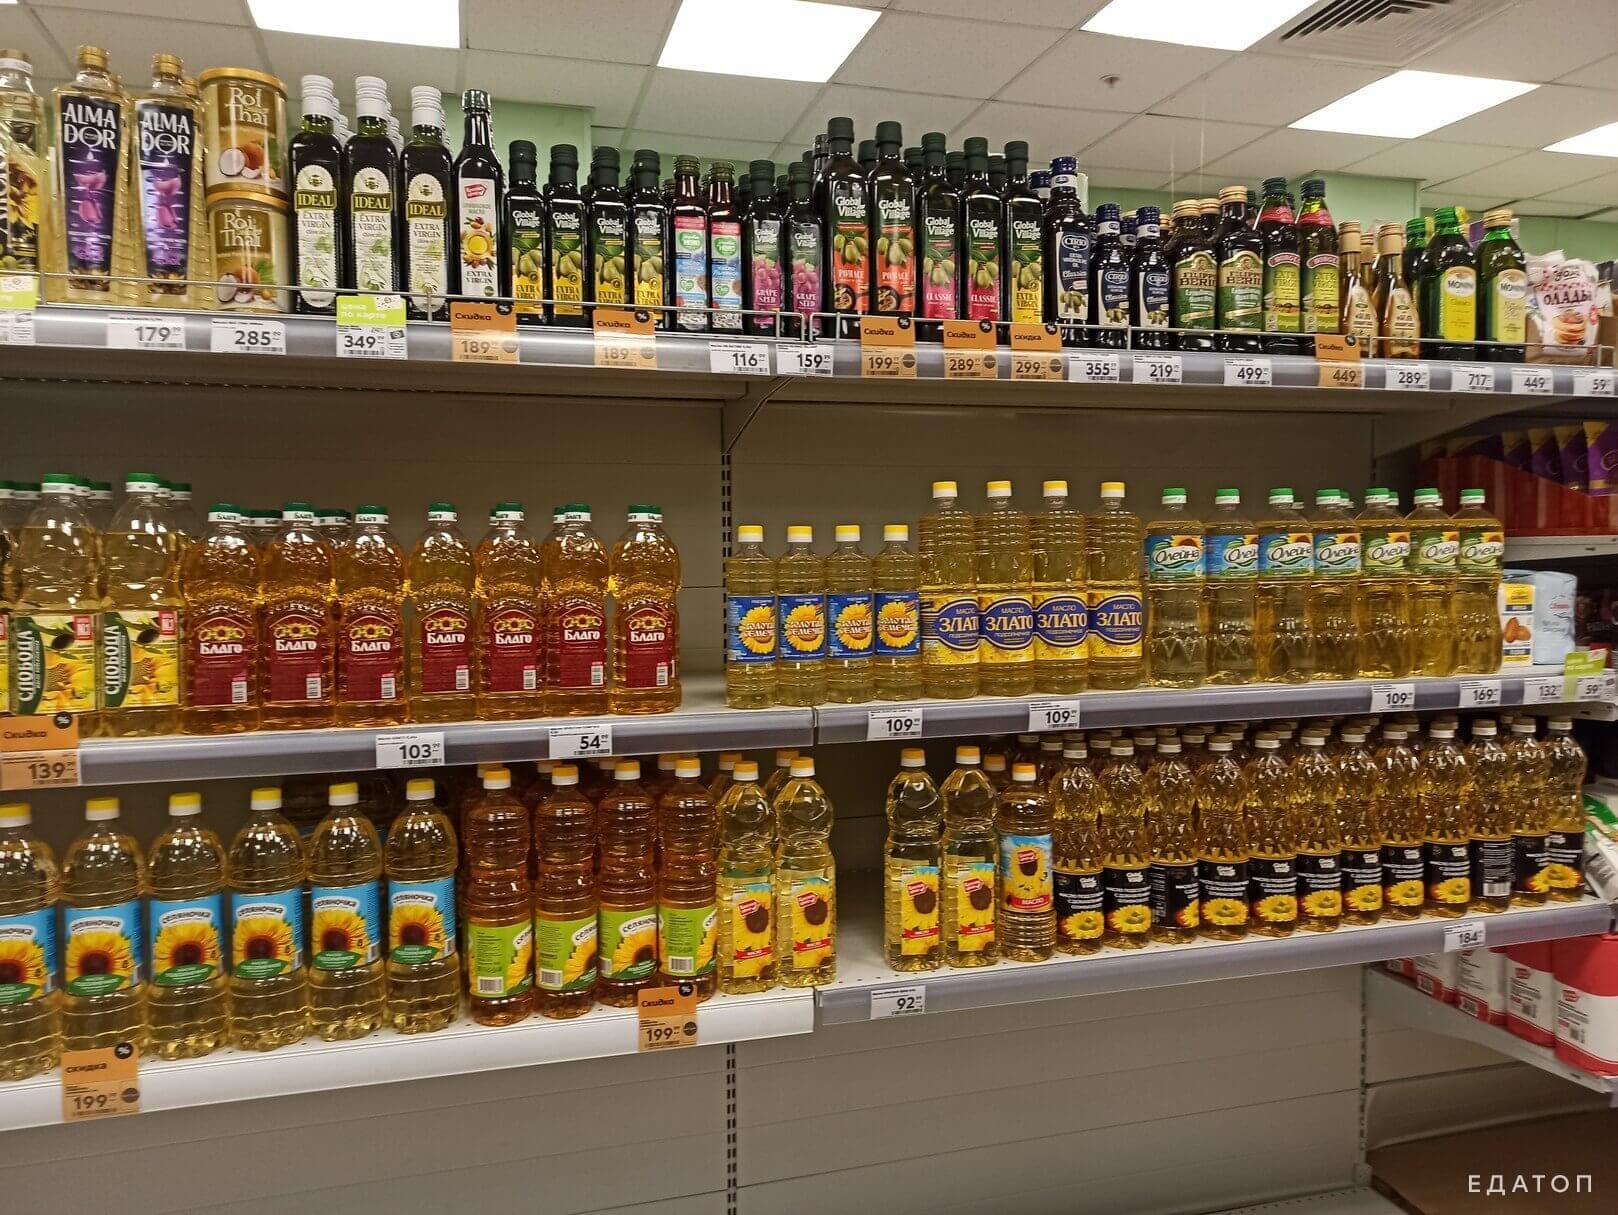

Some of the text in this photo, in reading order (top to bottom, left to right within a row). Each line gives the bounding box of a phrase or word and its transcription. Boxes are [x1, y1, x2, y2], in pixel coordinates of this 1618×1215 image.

[230, 88, 262, 107] Roi
[62, 103, 117, 130] ALMA
[225, 103, 269, 126] Thai
[140, 112, 191, 135] ALMA
[64, 123, 116, 149] DOR
[141, 131, 190, 155] DOR
[297, 193, 335, 206] IDEAL
[354, 196, 390, 209] IDEAL
[835, 196, 863, 208] Global
[879, 199, 907, 210] Global
[302, 212, 329, 220] EXTRA
[409, 204, 444, 216] IDEAL
[512, 210, 538, 220] Global
[837, 206, 866, 218] Village
[881, 208, 911, 220] Village
[223, 211, 255, 229] Roi
[359, 215, 386, 223] EXTRA
[552, 212, 578, 221] Global
[925, 217, 953, 228] Global
[358, 223, 388, 231] VIRGIN
[414, 223, 440, 231] EXTRA
[515, 218, 541, 228] Village
[555, 220, 580, 229] Village
[596, 218, 622, 228] Global
[634, 218, 659, 228] Global
[970, 220, 996, 230] Global
[1013, 221, 1039, 231] Global
[413, 230, 441, 238] VIRGIN
[600, 225, 624, 235] Village
[637, 225, 661, 235] Village
[928, 225, 955, 237] Village
[972, 228, 998, 239] Village
[1016, 229, 1041, 240] Village
[221, 228, 262, 247] Thai
[556, 286, 580, 294] EXTRA
[599, 291, 622, 299] EXTRA
[756, 289, 778, 297] GRAPE
[796, 293, 816, 301] GRAPE
[926, 293, 953, 301] CLASSIC
[971, 294, 997, 302] CLASSIC
[1016, 293, 1039, 301] EXTRA
[455, 311, 492, 321] Скидка
[596, 319, 631, 329] Скидка
[134, 327, 170, 342] 179
[234, 330, 271, 346] 285
[864, 328, 895, 336] Скидка
[946, 331, 977, 339] Скидка
[344, 335, 376, 348] 349
[461, 340, 490, 353] 189
[732, 353, 757, 367] 116
[796, 354, 822, 367] 159
[868, 356, 893, 370] 199
[949, 359, 974, 371] 289
[1015, 361, 1041, 373] 299
[1085, 363, 1110, 375] 355
[1150, 364, 1173, 377] 219
[1237, 367, 1263, 380] 499
[1333, 370, 1357, 382] 449
[1398, 372, 1420, 384] 289
[1468, 374, 1486, 386] 717
[1524, 377, 1546, 388] 449
[1593, 379, 1606, 390] 59
[1155, 548, 1200, 564] Олейна
[1228, 548, 1258, 561] Олей
[1001, 606, 1024, 614] МАСЛО
[985, 615, 1033, 631] ЗЛАТО
[1037, 613, 1088, 628] ЗЛАТО
[104, 624, 120, 695] СЛОБОДА
[17, 630, 34, 702] СЛОБОДА
[1472, 689, 1493, 701] 169
[1538, 685, 1557, 696] 132
[1585, 683, 1598, 695] 59
[1386, 693, 1407, 706] 109
[1045, 711, 1071, 724] 109
[886, 718, 914, 732] 109
[4, 730, 47, 739] Скидка
[579, 734, 601, 750] 54
[399, 744, 432, 760] 103
[28, 763, 65, 780] 139
[1458, 932, 1478, 945] 184
[640, 998, 675, 1008] Скидка
[896, 997, 915, 1010] 92
[646, 1027, 673, 1041] 199
[65, 1062, 107, 1073] скидка
[73, 1094, 108, 1110] 199
